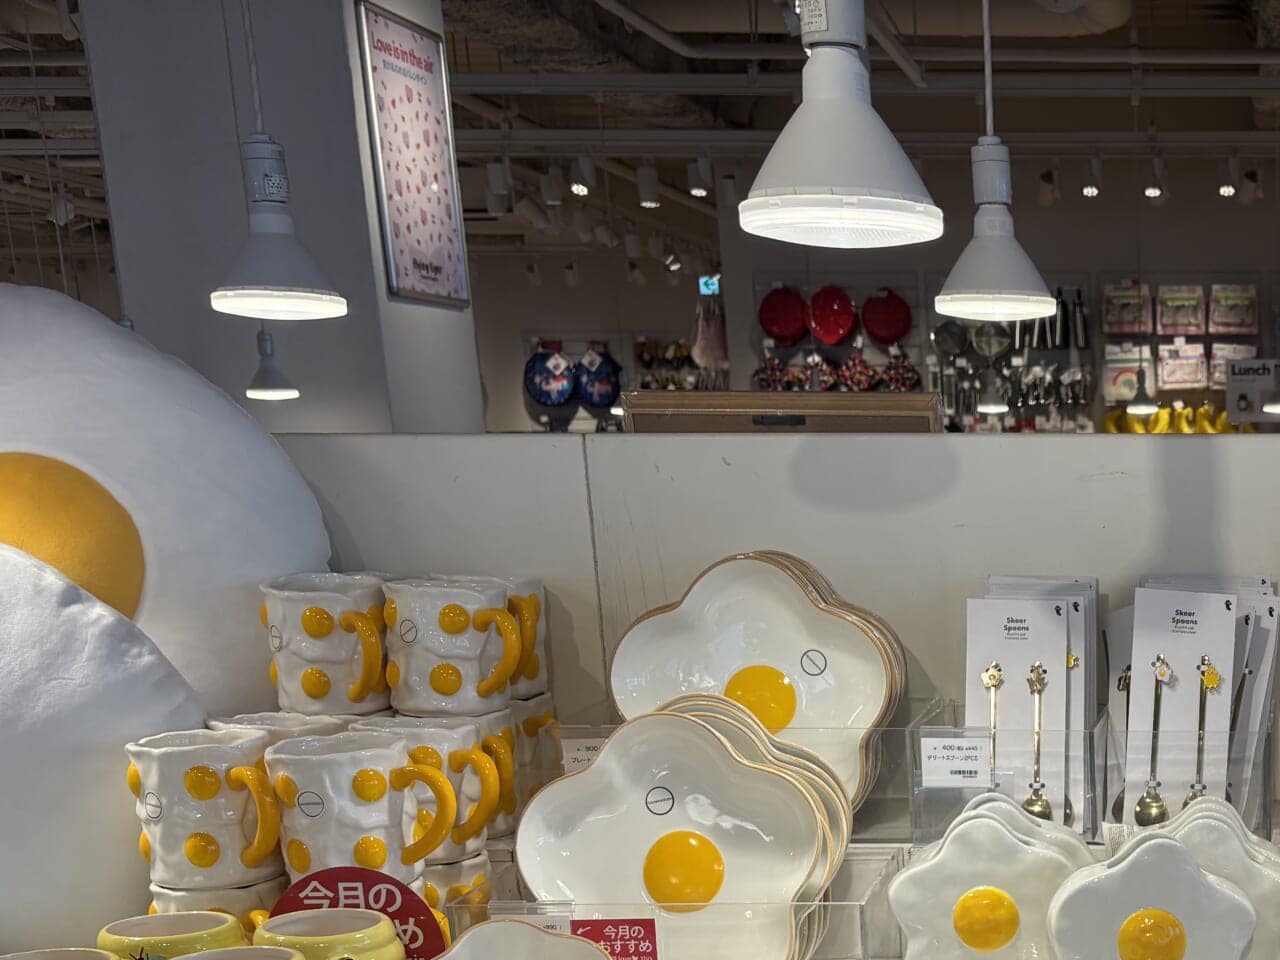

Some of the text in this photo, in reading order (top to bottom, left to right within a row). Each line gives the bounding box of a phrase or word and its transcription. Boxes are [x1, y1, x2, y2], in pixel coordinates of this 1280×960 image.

[1231, 363, 1271, 376] Lunch
[299, 881, 402, 913] 今月の
[603, 925, 645, 939] 今月の
[599, 940, 653, 953] おすすめ
